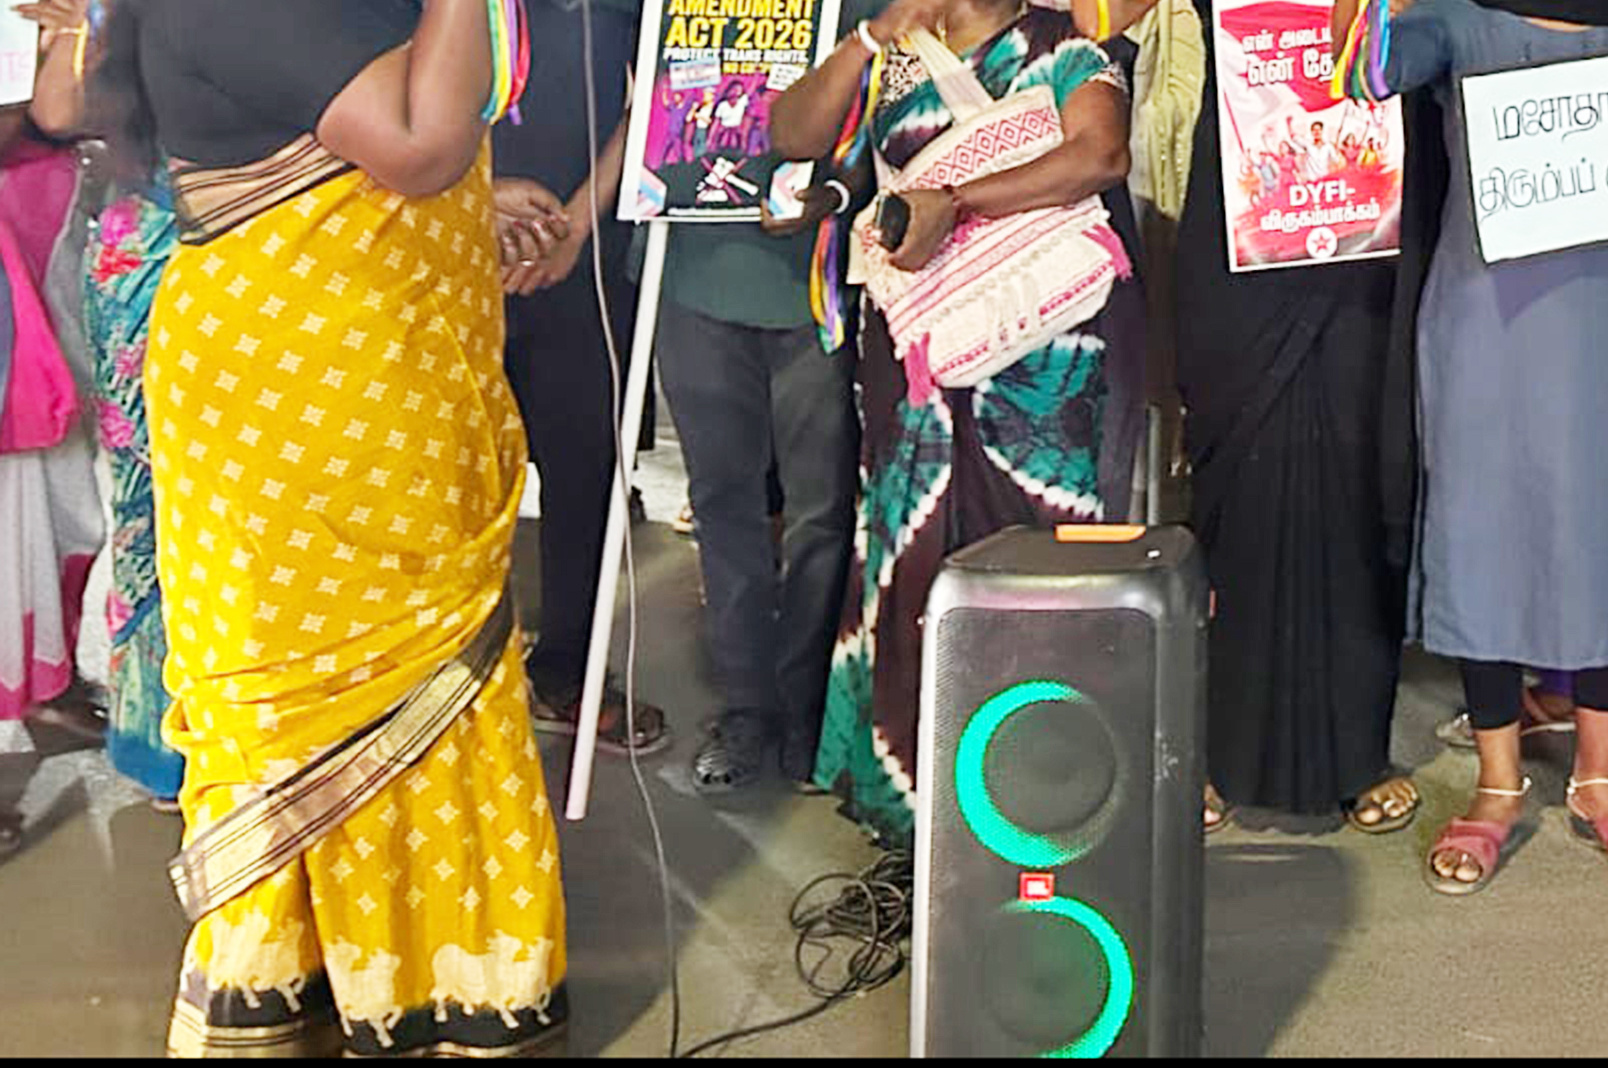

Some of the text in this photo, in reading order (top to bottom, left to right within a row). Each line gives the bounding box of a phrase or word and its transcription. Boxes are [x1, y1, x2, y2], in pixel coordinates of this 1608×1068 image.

[664, 17, 813, 50] ACT 2026
[1248, 50, 1296, 87] என்
[1260, 197, 1381, 233] விருகம்பாக்கம்
